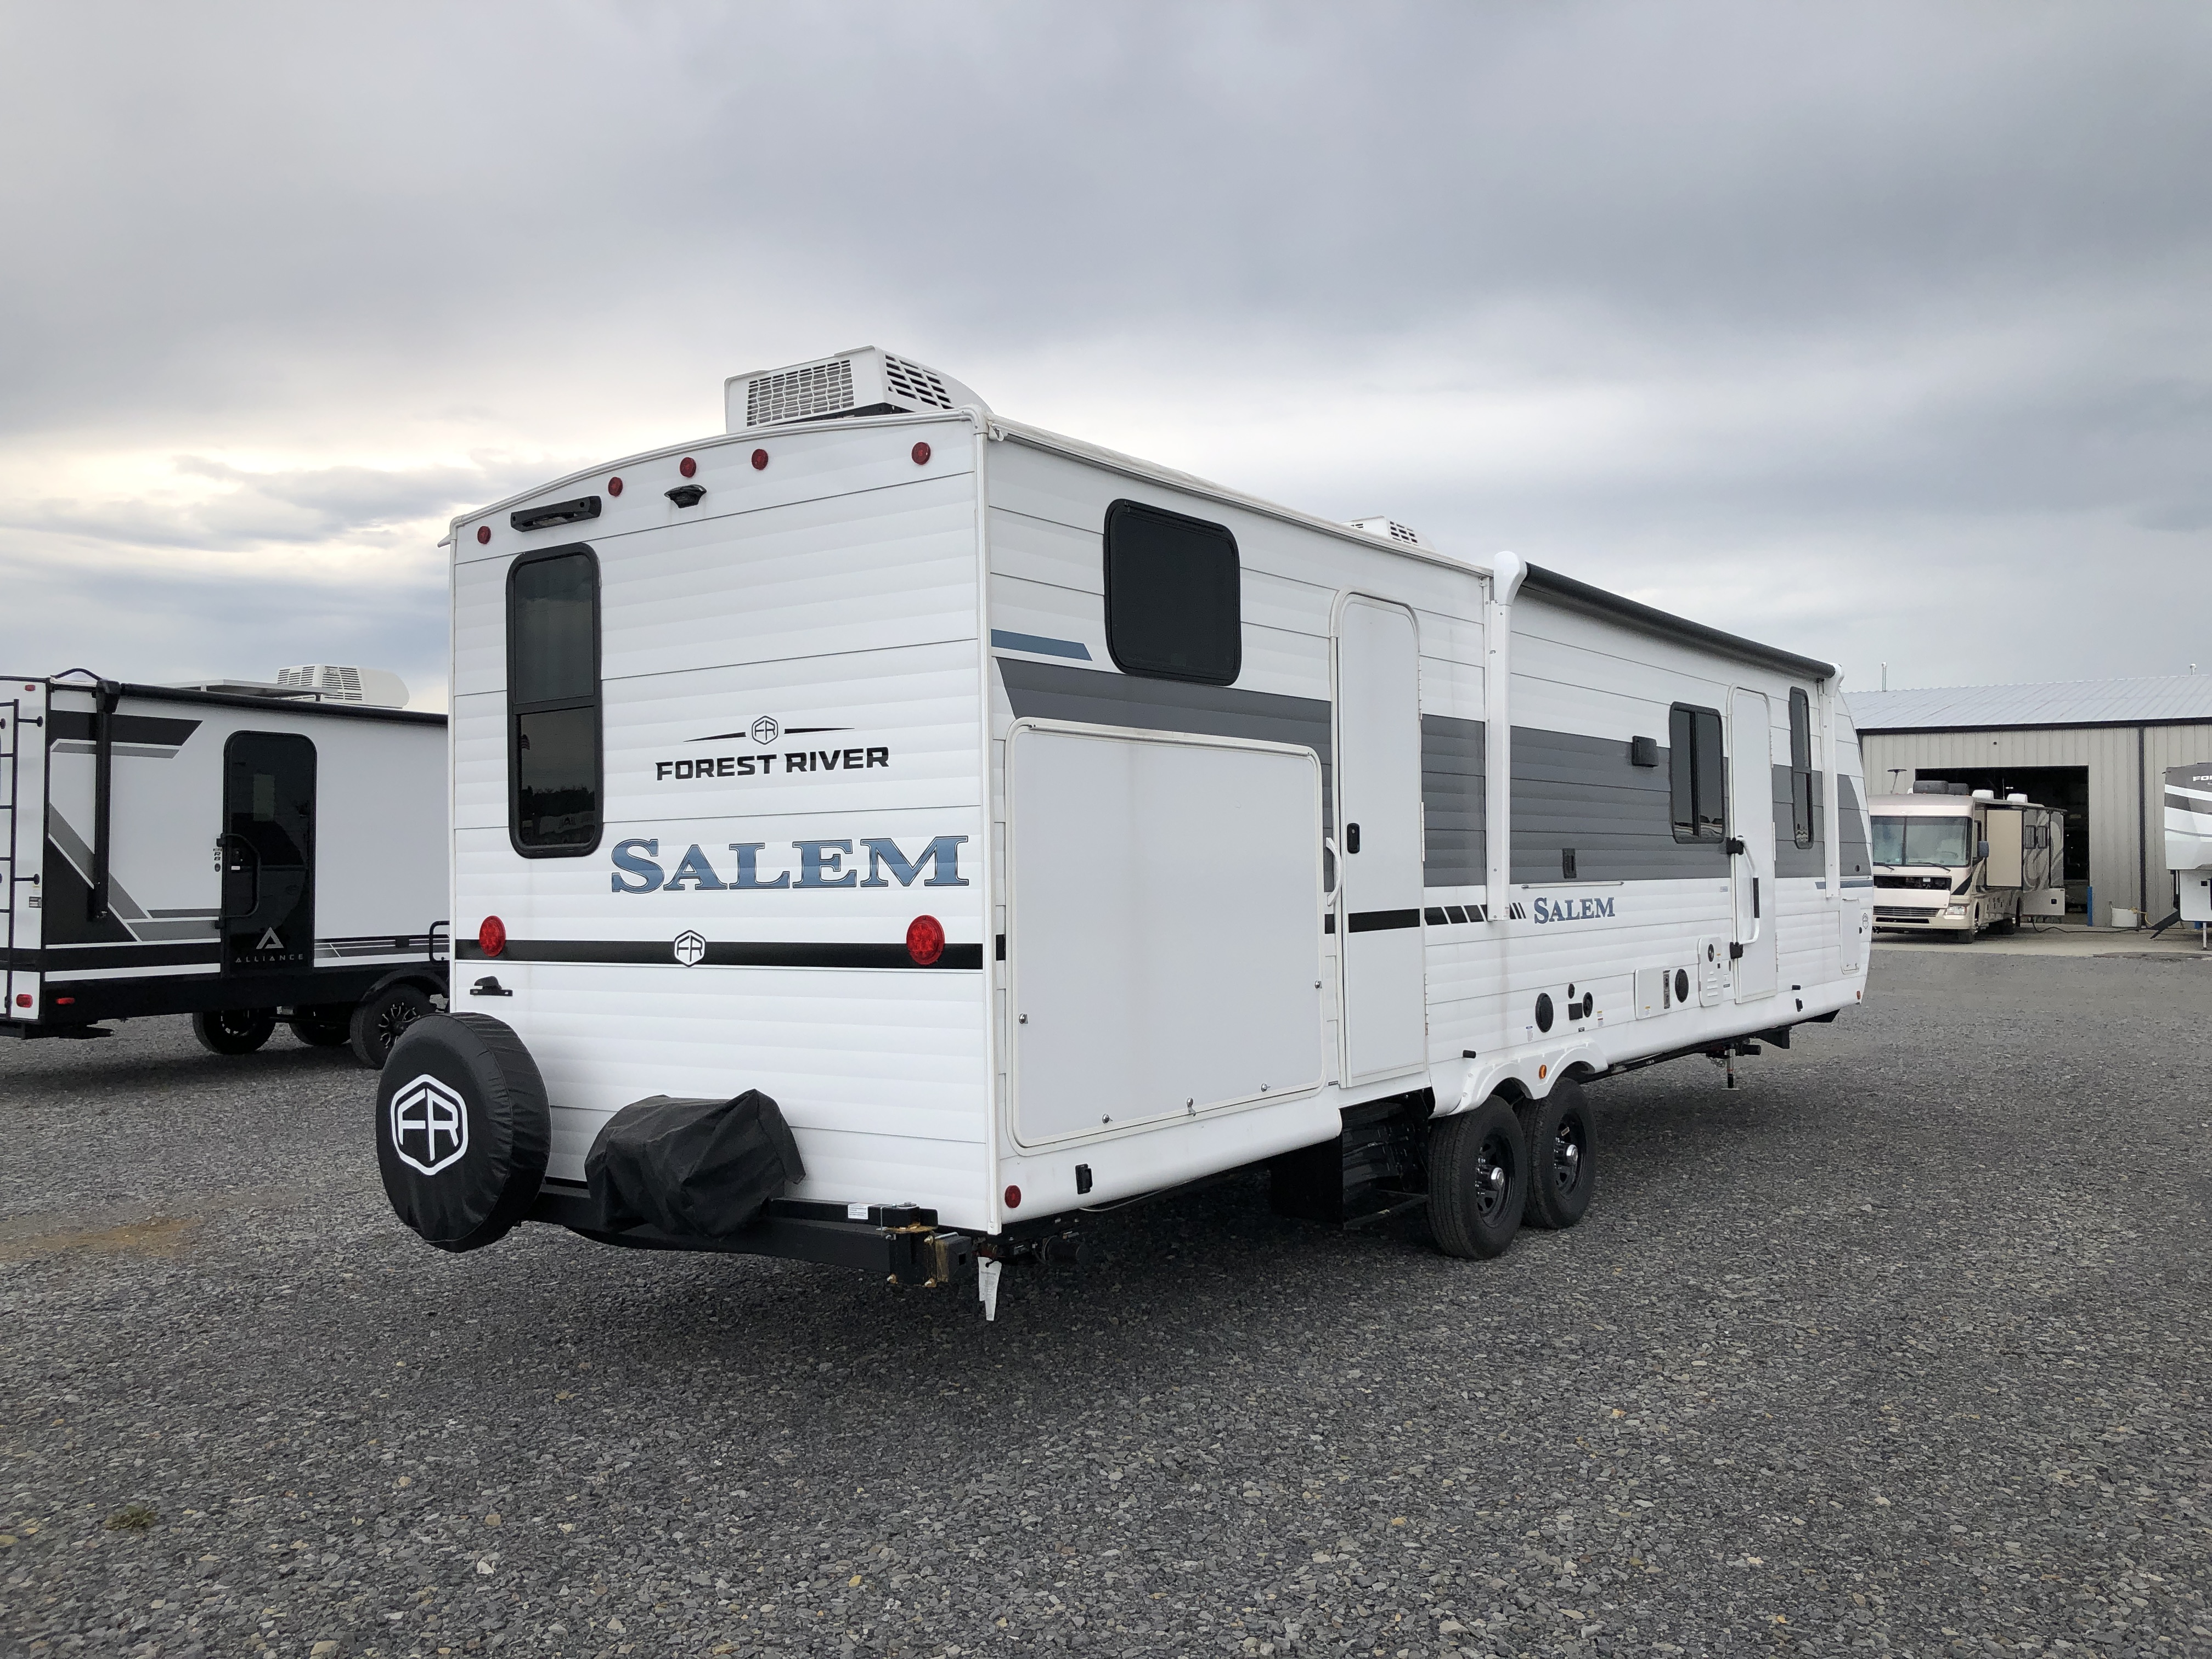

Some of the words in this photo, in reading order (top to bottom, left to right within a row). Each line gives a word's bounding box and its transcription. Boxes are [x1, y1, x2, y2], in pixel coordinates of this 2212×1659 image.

[655, 754, 777, 781] FOREST
[784, 746, 889, 774] RIVER
[611, 835, 969, 894] SALEM
[1533, 896, 1616, 924] SALEM
[235, 953, 303, 963] ALLIANCE
